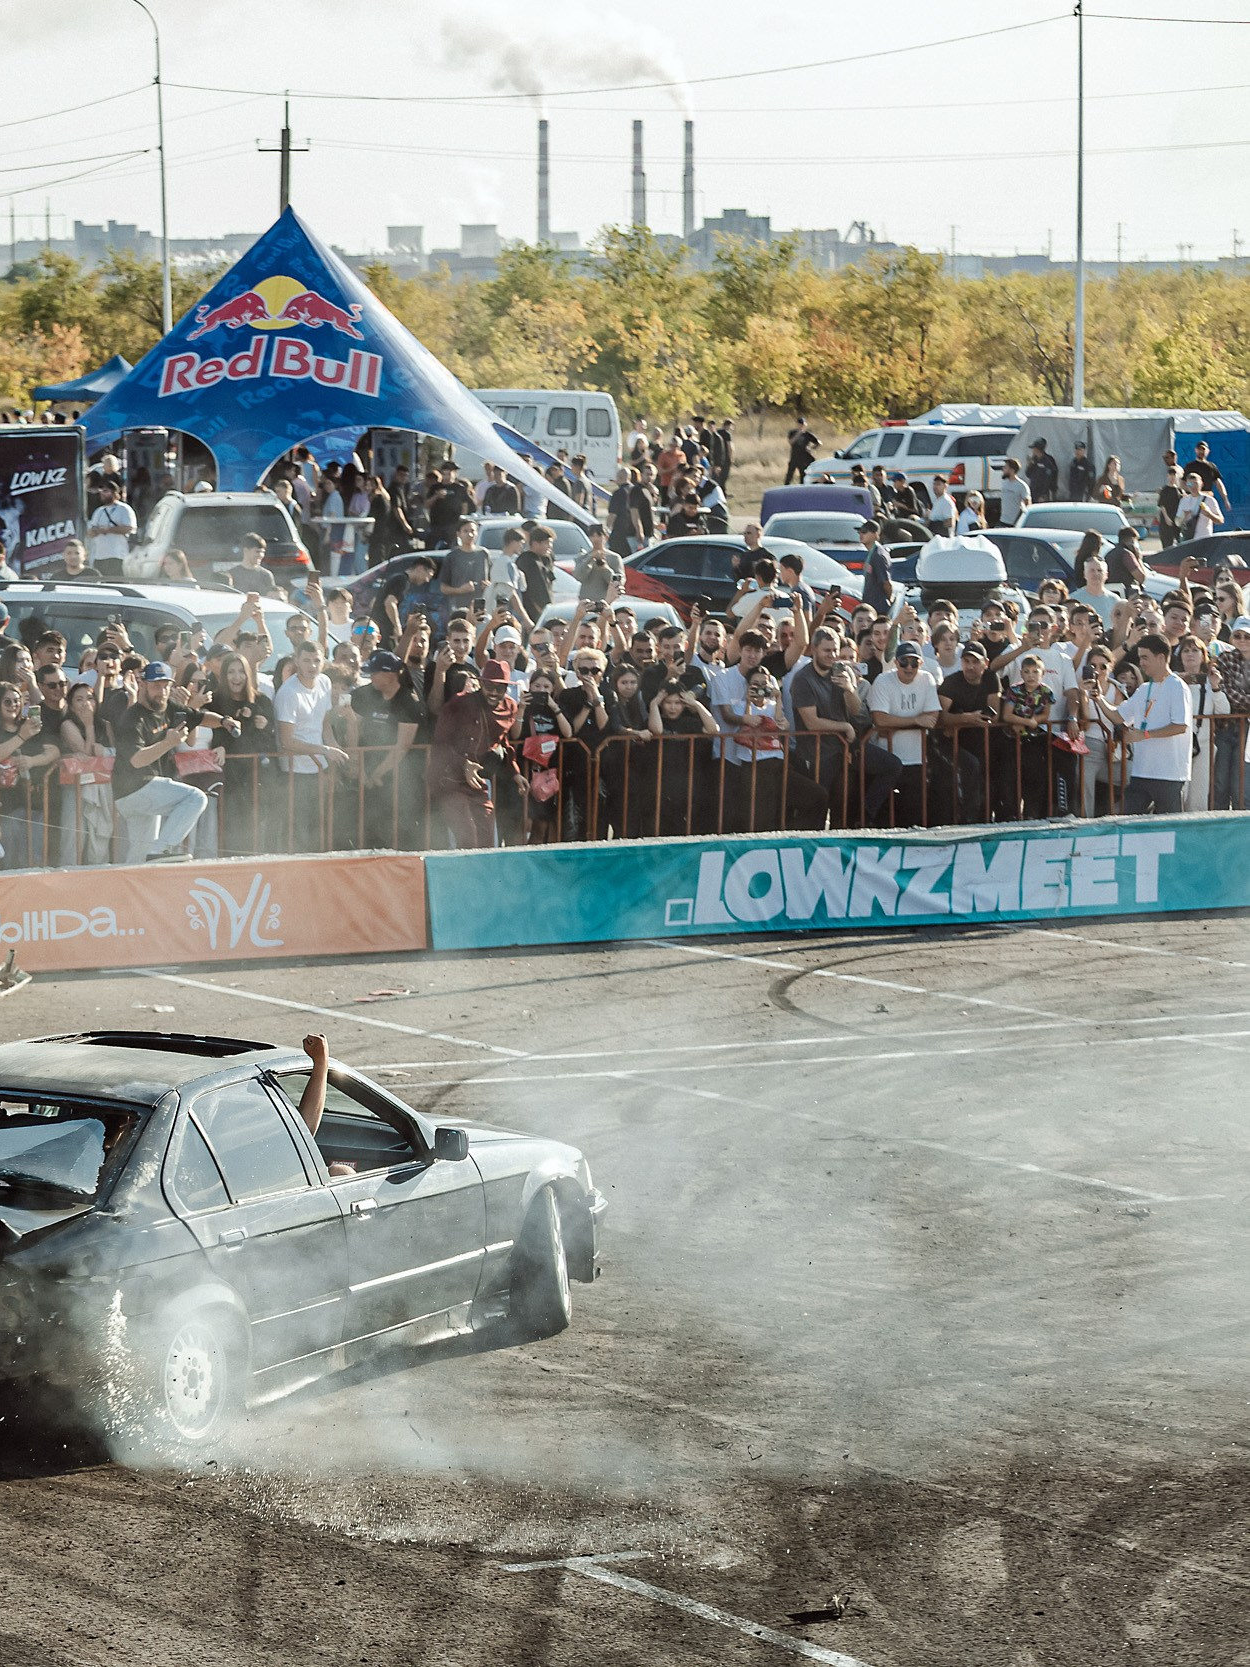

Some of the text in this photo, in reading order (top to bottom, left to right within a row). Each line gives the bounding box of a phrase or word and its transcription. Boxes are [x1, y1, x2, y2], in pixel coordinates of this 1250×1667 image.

[158, 335, 382, 397] Red Bull
[9, 467, 68, 490] LOW KZ
[25, 519, 76, 548] КАССА
[693, 831, 1176, 926] LOWKZMEET
